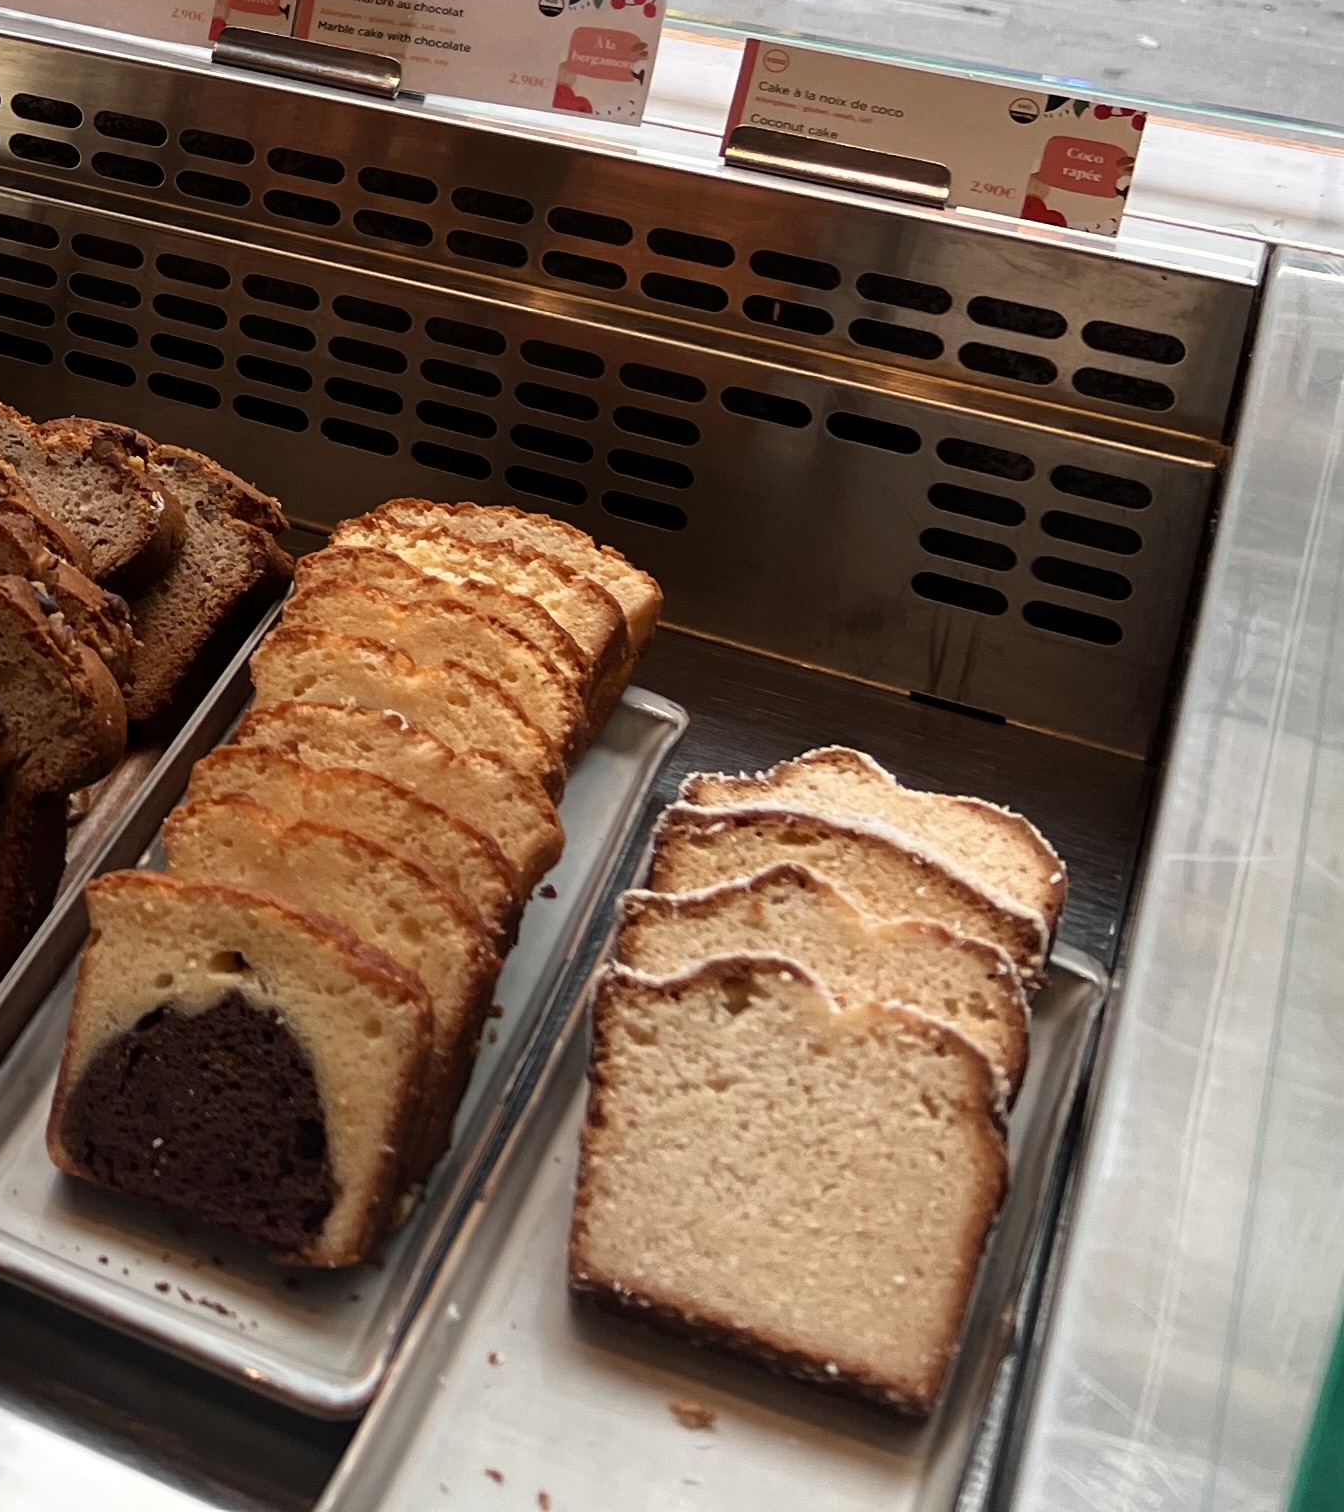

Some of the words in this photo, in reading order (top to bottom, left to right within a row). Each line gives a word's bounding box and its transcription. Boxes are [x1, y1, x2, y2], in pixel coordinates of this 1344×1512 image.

[397, 0, 411, 10] au
[414, 2, 464, 18] chocolat
[318, 20, 354, 34] Marble
[358, 28, 384, 39] cake
[387, 31, 411, 43] with
[414, 36, 472, 53] chocolate
[759, 81, 790, 96] Cake
[793, 88, 801, 98] à
[805, 90, 816, 101] la
[819, 95, 848, 107] noix
[850, 100, 868, 111] de
[871, 104, 904, 118] coco
[750, 113, 805, 133] Coconut
[808, 126, 838, 140] cake
[1066, 147, 1104, 164] Coco
